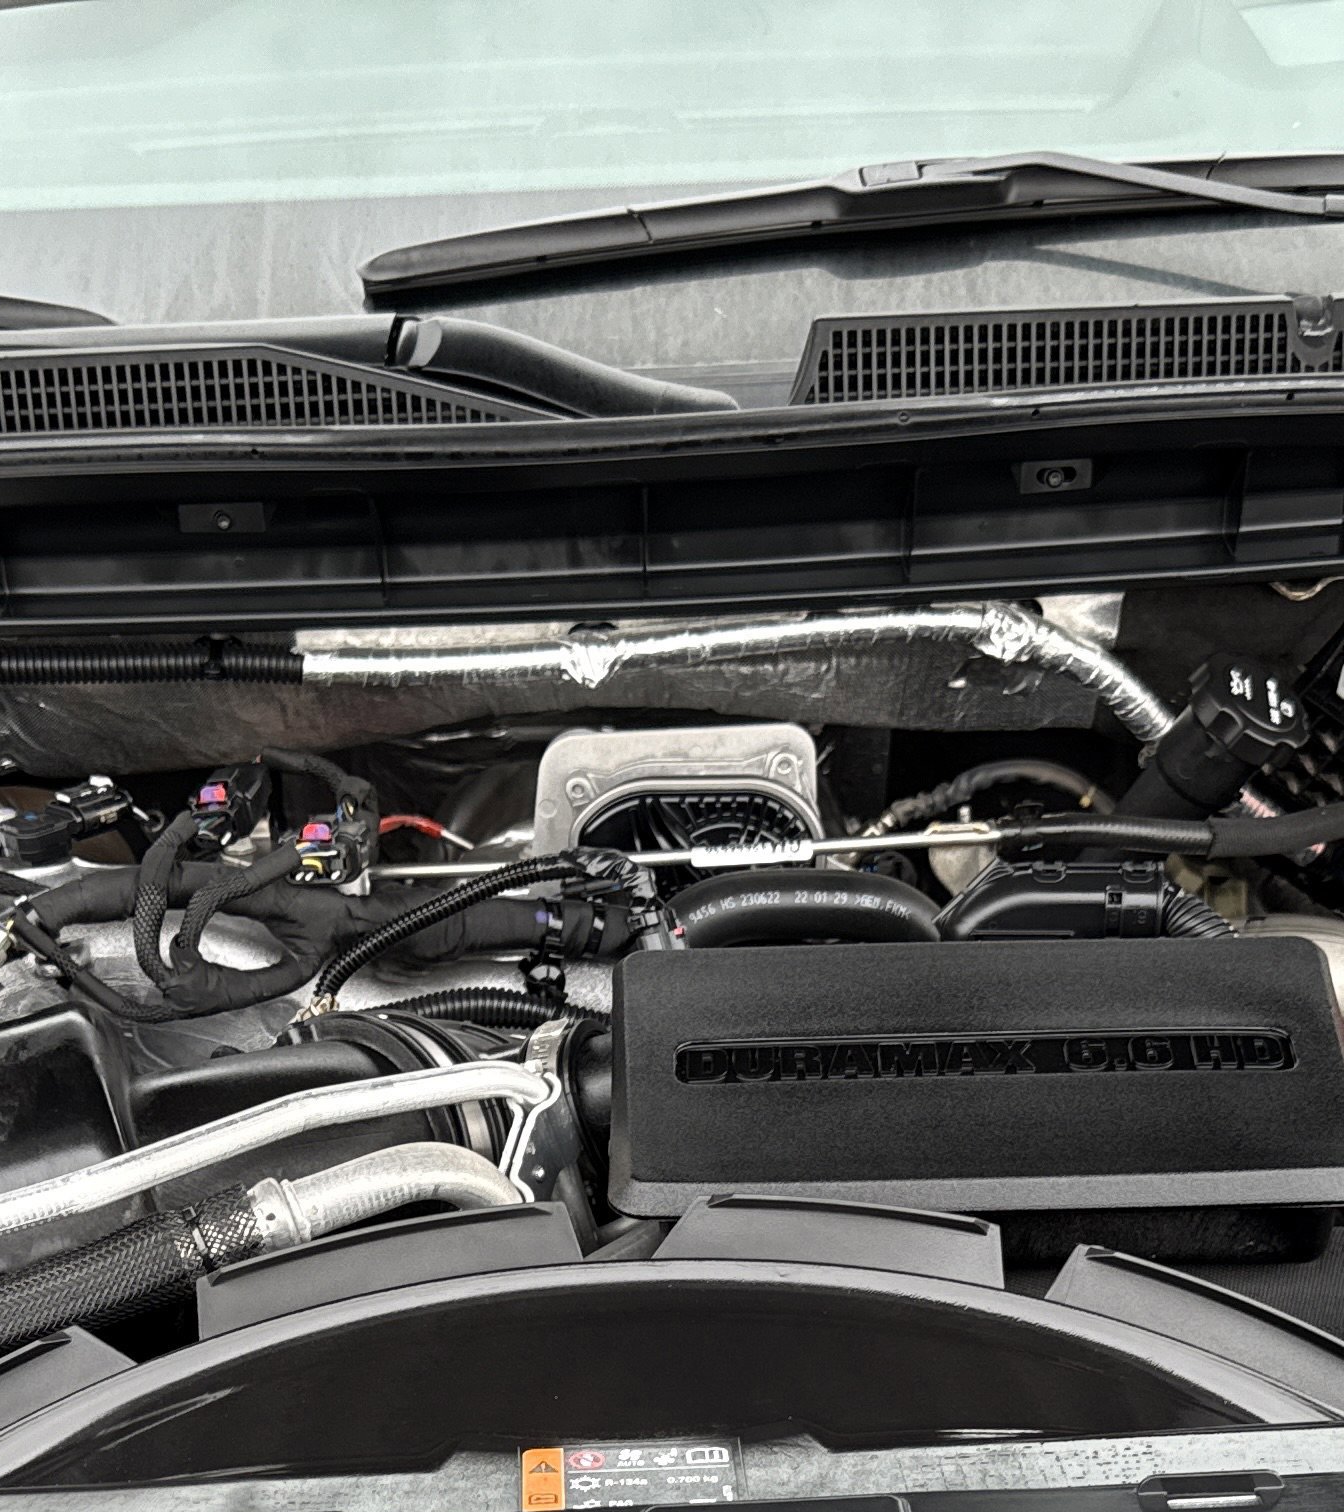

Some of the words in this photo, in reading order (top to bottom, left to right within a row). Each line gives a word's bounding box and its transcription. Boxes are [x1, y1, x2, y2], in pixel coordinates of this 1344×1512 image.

[686, 1038, 1038, 1084] DURAMAX
[1062, 1036, 1175, 1073] 6.6
[1190, 1033, 1289, 1071] HD
